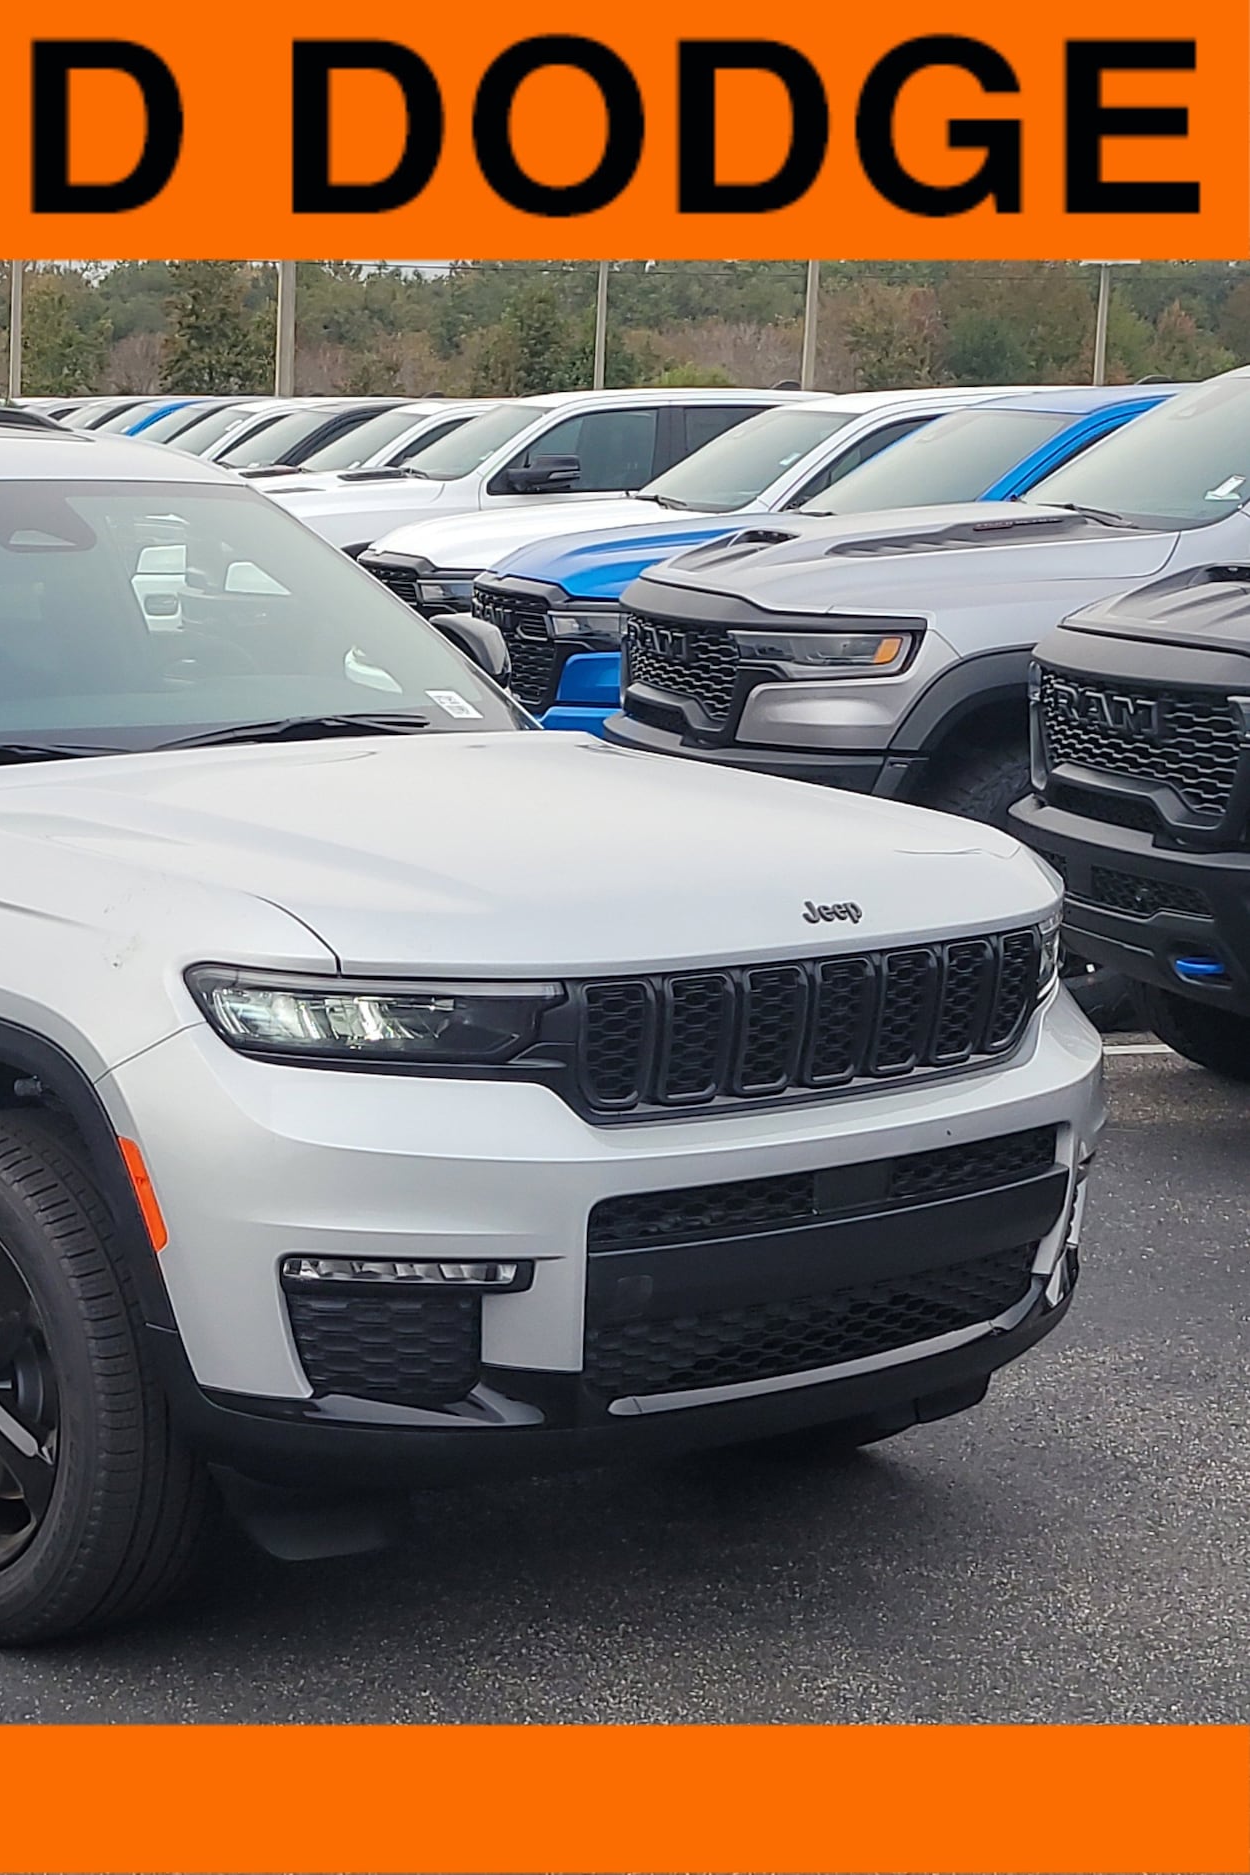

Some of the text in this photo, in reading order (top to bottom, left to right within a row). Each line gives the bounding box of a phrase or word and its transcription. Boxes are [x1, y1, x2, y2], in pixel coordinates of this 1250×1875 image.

[627, 620, 687, 660] RAM
[1052, 683, 1158, 736] RAM
[802, 900, 863, 924] Jeep
